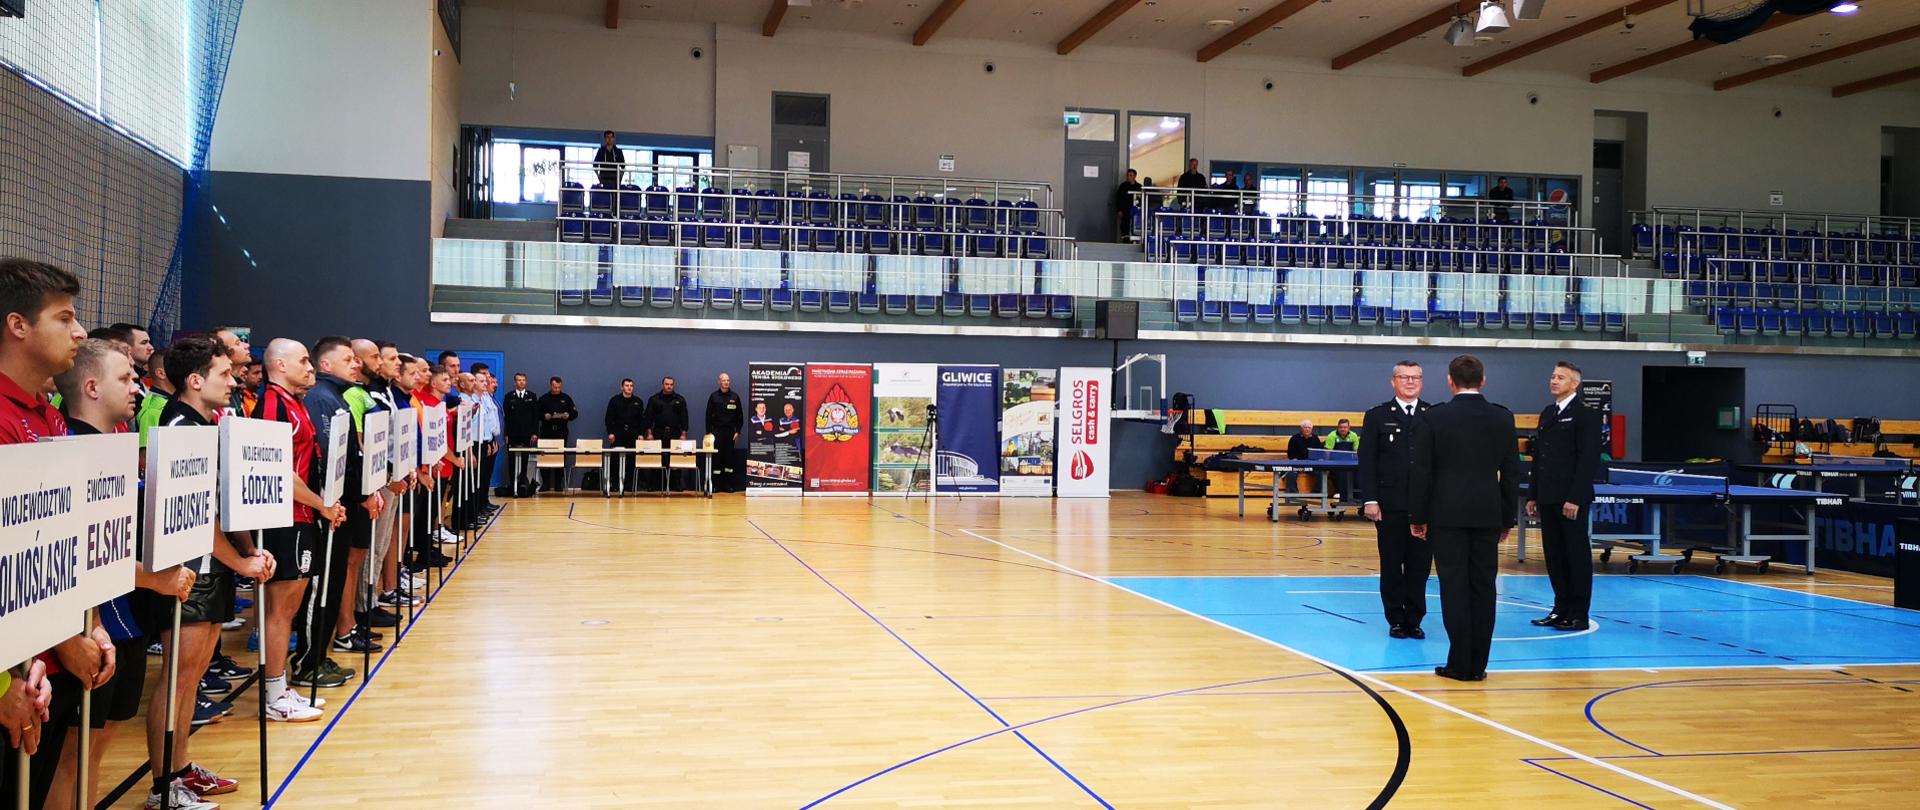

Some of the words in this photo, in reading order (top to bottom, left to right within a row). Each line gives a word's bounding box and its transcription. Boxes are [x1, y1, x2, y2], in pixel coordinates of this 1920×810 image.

[942, 372, 992, 383] GLIWICE
[1072, 379, 1084, 445] SELGROS
[1088, 384, 1098, 409] carry
[1087, 419, 1096, 440] cash
[170, 453, 208, 479] WOJEWÓDZTWO
[242, 443, 283, 463] WOJEWÓDZTWO
[87, 471, 125, 503] EWÓDZTWO
[242, 466, 283, 505] ŁÓDZKIE
[2, 482, 72, 527] WOJEWÓDZTWO
[163, 490, 210, 535] LUBUSKIE
[1816, 498, 1842, 506] TIBHAR
[86, 515, 132, 571] ELSKIE
[1815, 515, 1896, 558] TIBHA
[1900, 542, 1920, 552] TIBH
[0, 530, 78, 618] OLNOŚLASKIE
